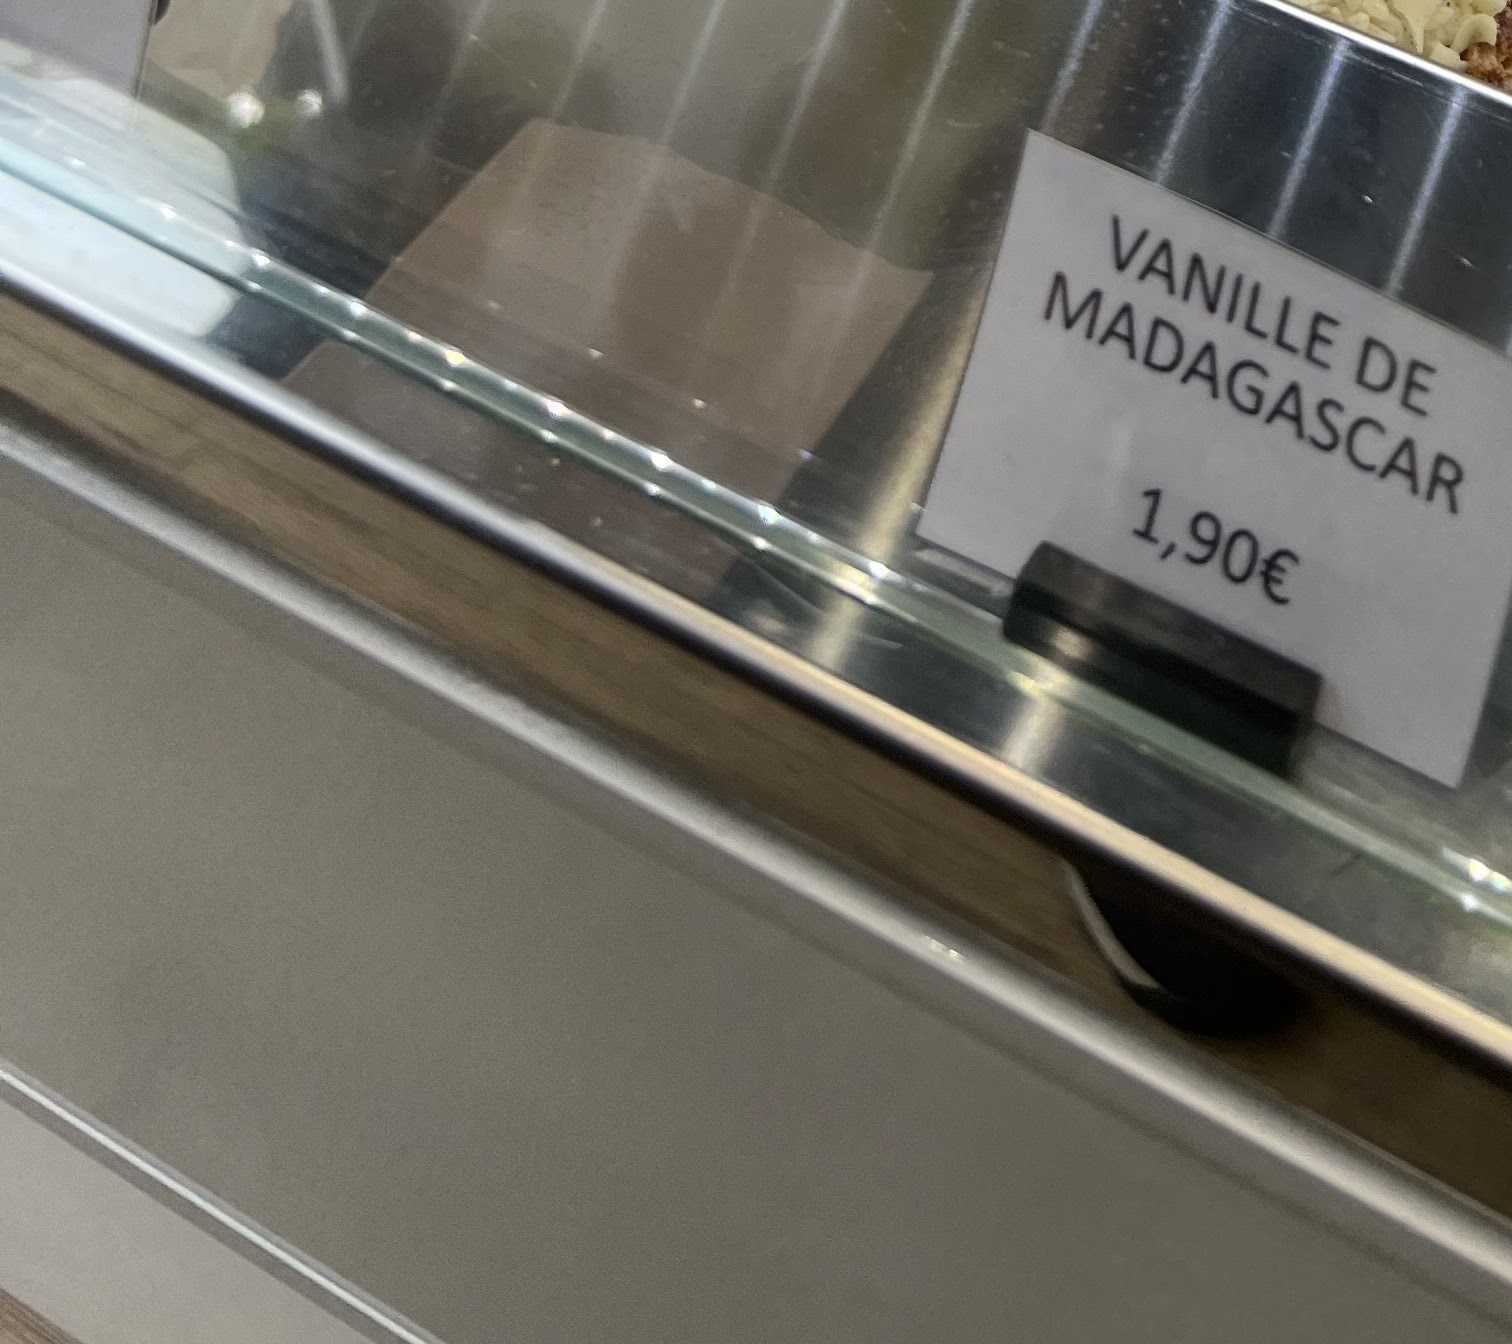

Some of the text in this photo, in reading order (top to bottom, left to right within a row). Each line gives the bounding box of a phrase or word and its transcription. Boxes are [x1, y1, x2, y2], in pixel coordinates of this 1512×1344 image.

[1044, 271, 1465, 514] MADAGASCAR
[1112, 216, 1437, 416] VANILLE DE
[1132, 488, 1299, 604] 1,90€
